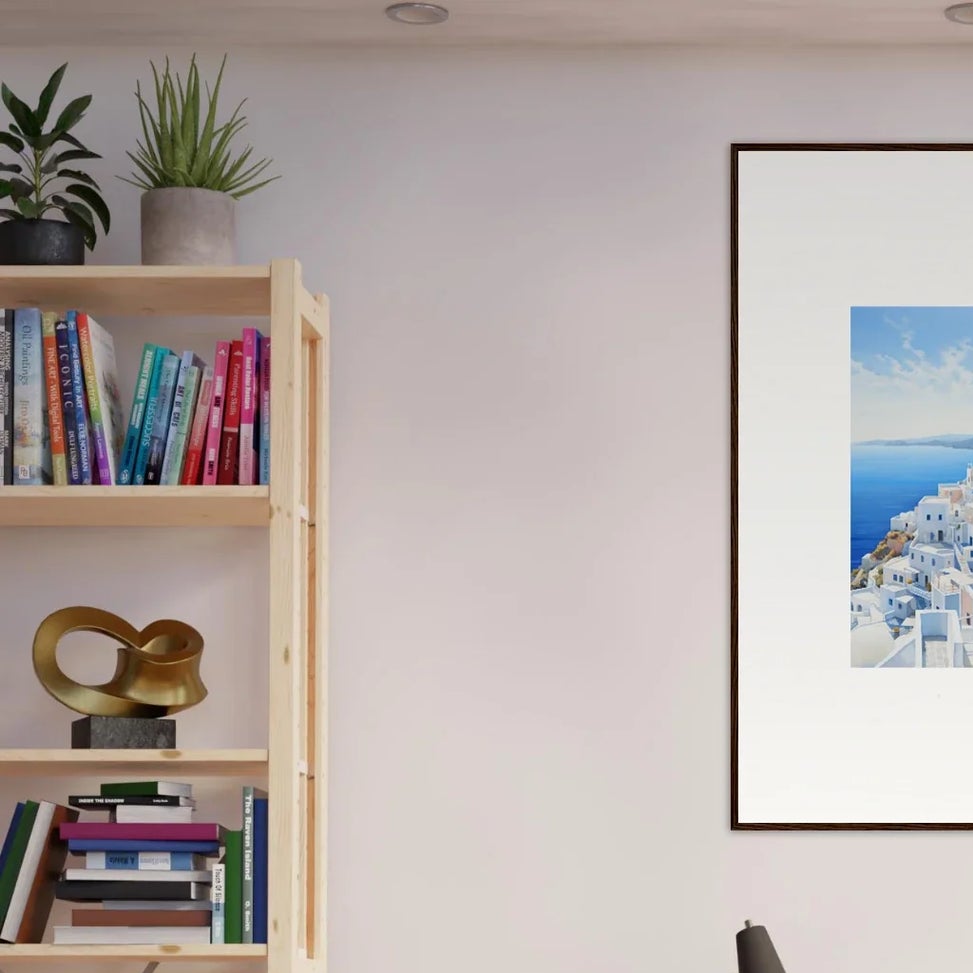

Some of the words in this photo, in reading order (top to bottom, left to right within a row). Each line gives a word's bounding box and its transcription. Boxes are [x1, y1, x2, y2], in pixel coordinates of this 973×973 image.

[22, 325, 32, 339] Oil
[20, 342, 31, 385] Paintings
[46, 347, 55, 364] FINE
[48, 365, 56, 378] ART
[59, 344, 73, 408] ICONIC
[80, 326, 92, 373] Watercolor
[86, 375, 97, 411] Portraits
[230, 363, 240, 396] Parenting
[49, 384, 58, 404] With
[49, 405, 60, 424] Digital
[229, 396, 237, 415] Skills
[52, 425, 61, 442] Tools
[214, 868, 222, 883] Touch
